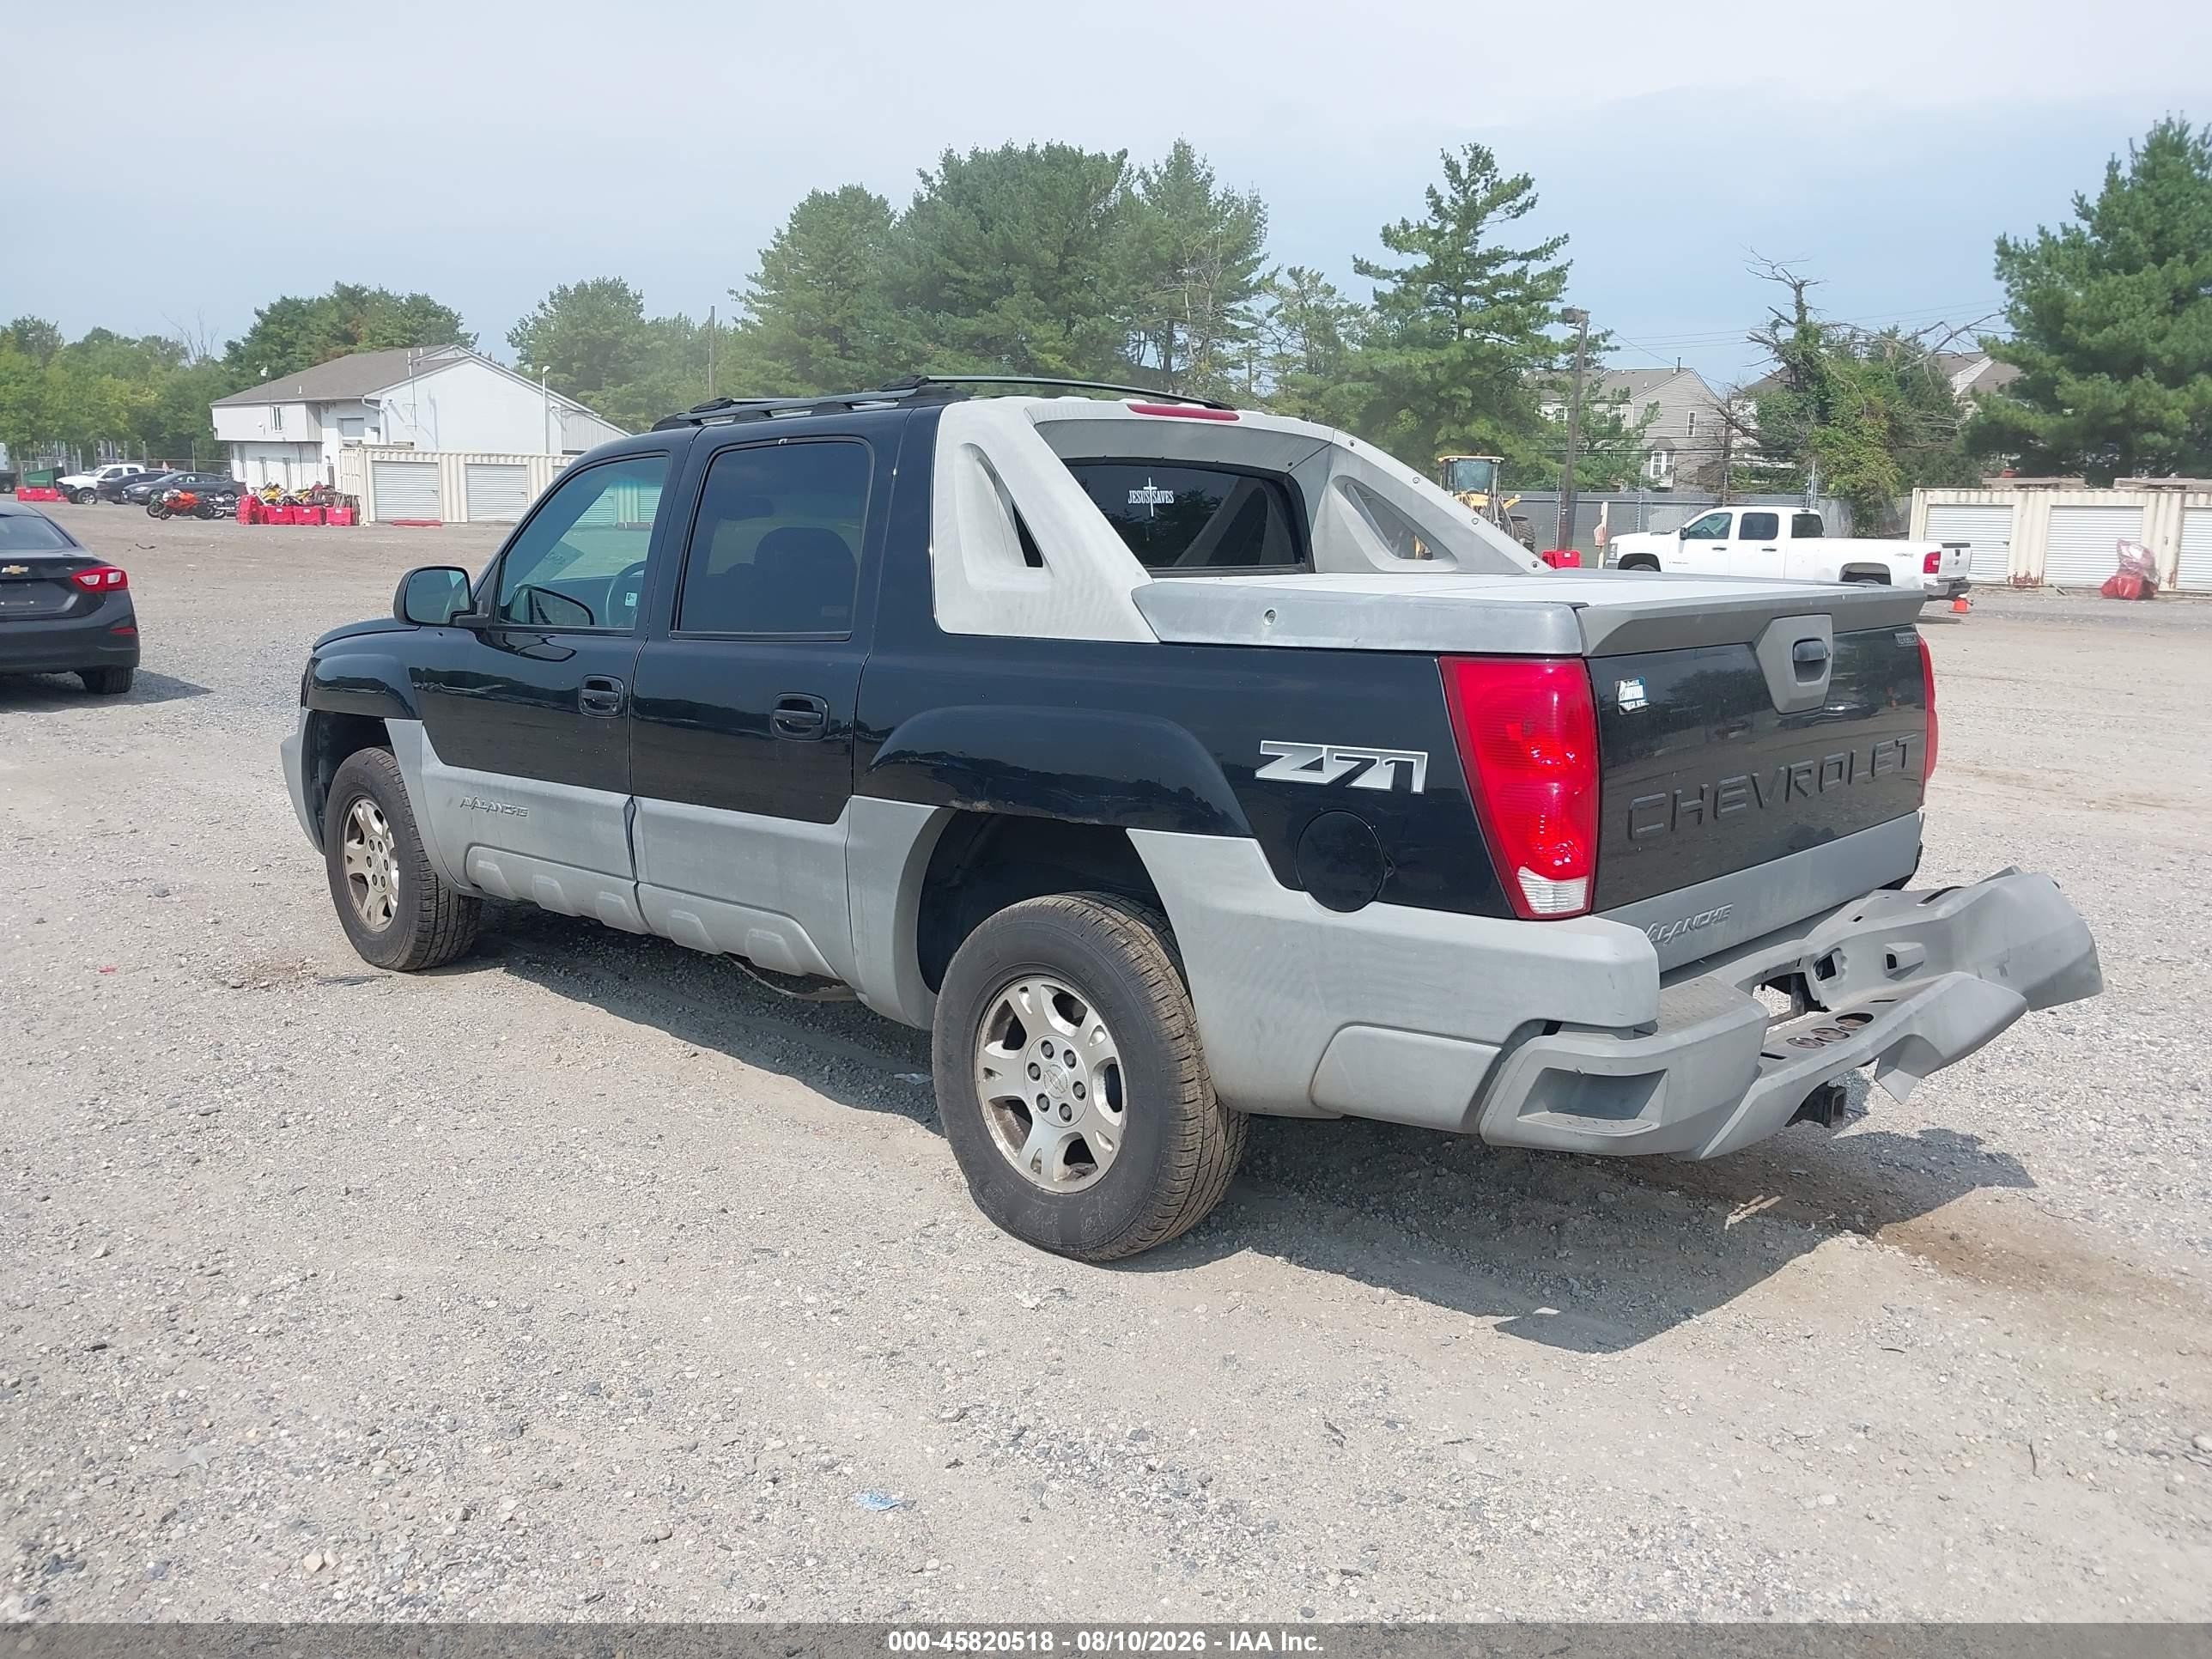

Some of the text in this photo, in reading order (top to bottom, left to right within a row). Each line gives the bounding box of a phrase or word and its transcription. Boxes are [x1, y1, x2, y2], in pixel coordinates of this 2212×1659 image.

[1127, 489, 1175, 504] JESUS SAVES
[1255, 739, 1429, 795] Z71
[1627, 732, 1917, 841] CHEVROLET
